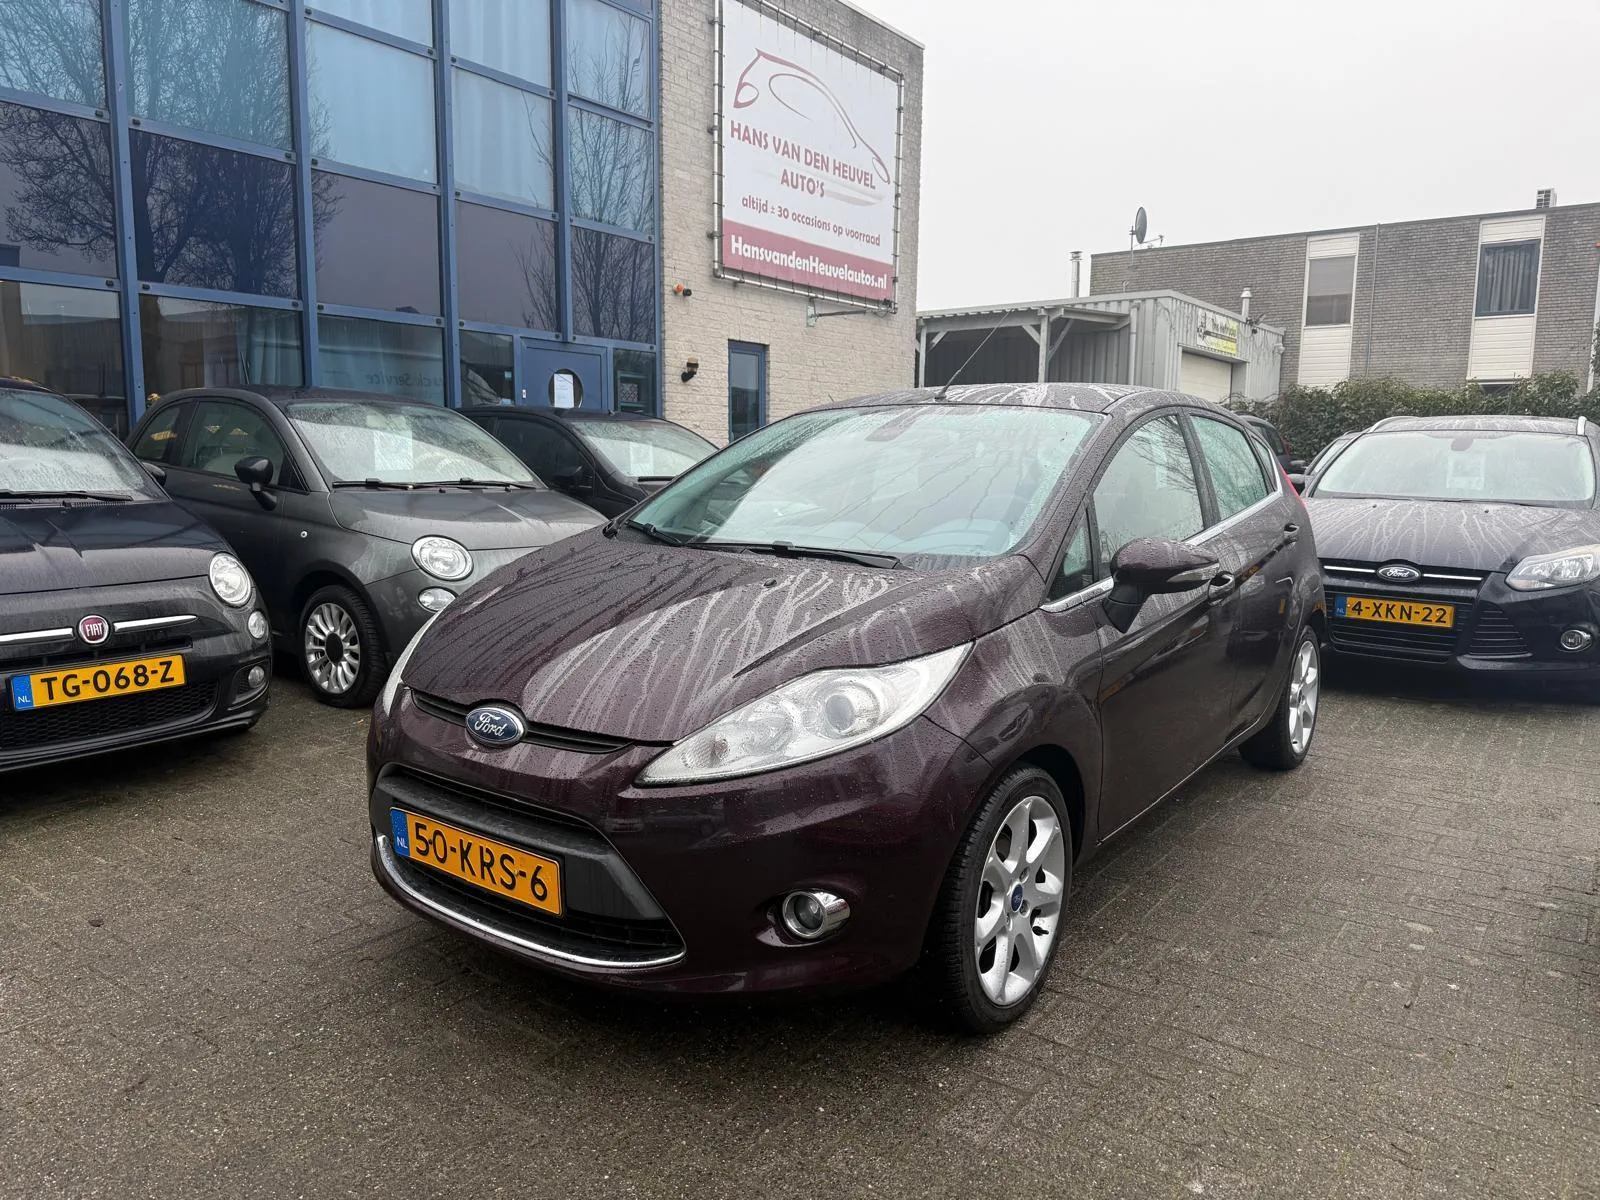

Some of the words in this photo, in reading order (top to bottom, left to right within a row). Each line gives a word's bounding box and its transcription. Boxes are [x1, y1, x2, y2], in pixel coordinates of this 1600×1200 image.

[731, 120, 769, 150] HANS
[773, 135, 801, 163] VAN
[804, 148, 830, 172] DEN
[833, 159, 876, 189] HEUVEL
[781, 168, 825, 197] AUTO'S
[742, 195, 768, 214] altijd
[777, 205, 790, 219] 30
[792, 212, 831, 232] occasions
[833, 225, 844, 237] op
[845, 229, 881, 247] voorraad
[731, 234, 888, 290] HansvandenHeuvelautos.nl
[1386, 566, 1410, 578] Ford
[1336, 607, 1345, 615] NL
[1351, 600, 1447, 624] 4-XKN-22
[85, 622, 103, 637] FIAT
[40, 660, 175, 700] TG-068-Z
[17, 695, 31, 703] NL
[474, 712, 508, 738] Ford
[396, 836, 408, 850] NL
[414, 821, 548, 901] 50-KRS-6
